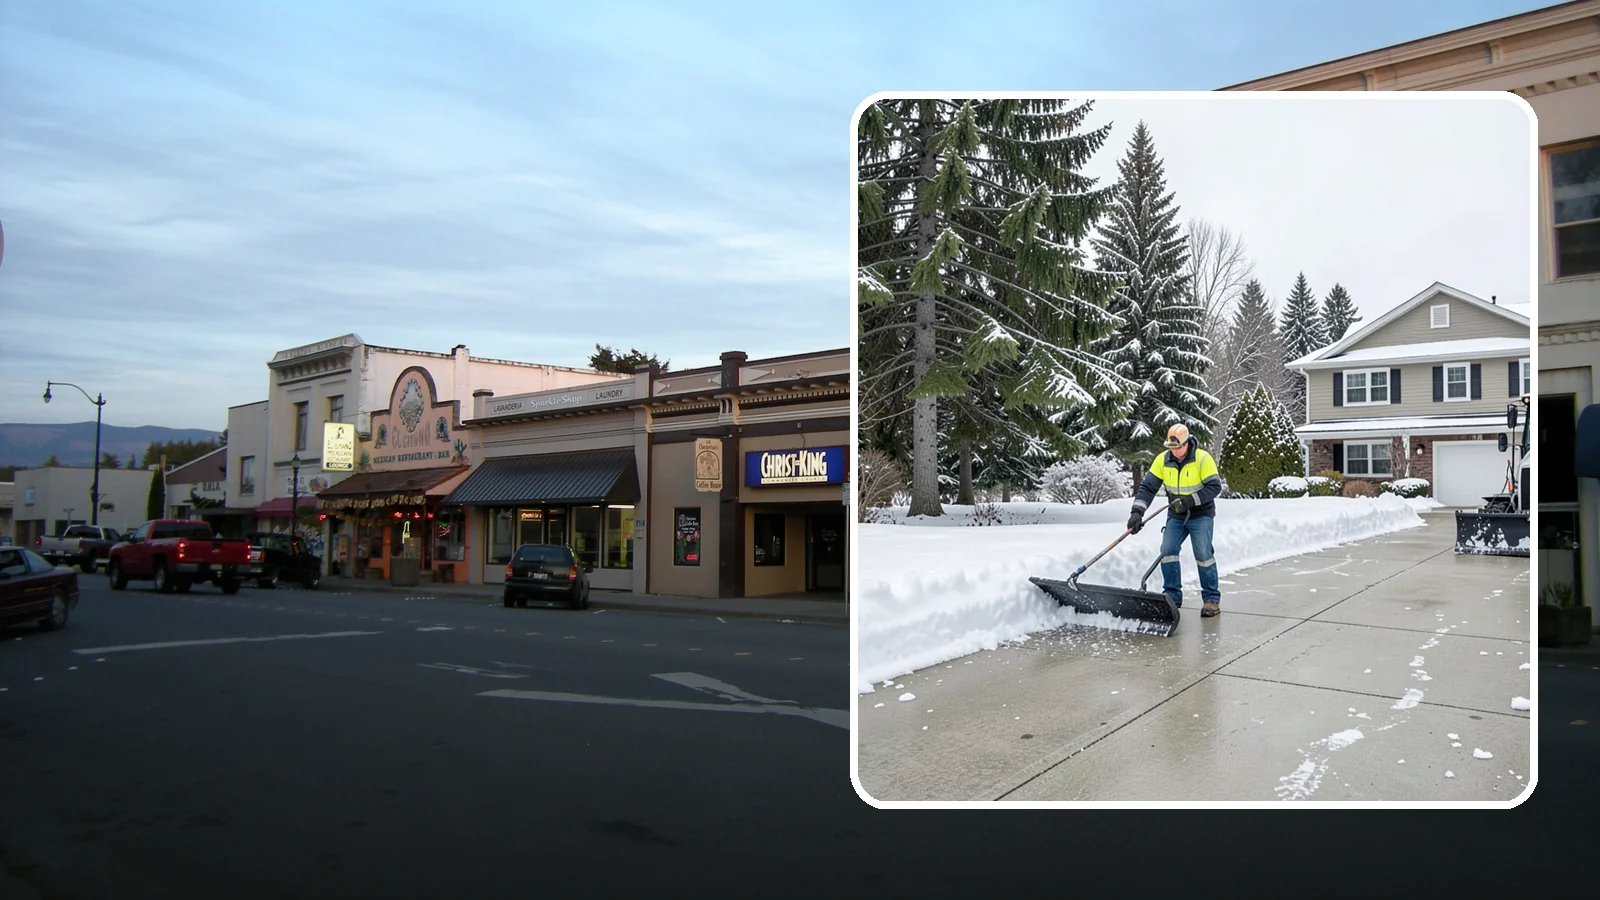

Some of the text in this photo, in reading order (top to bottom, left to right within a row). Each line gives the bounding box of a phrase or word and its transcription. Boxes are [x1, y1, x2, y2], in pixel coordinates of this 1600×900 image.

[493, 389, 623, 412] LAVANDERIA Sparkle Shop LAUNDRY
[392, 425, 401, 449] EL
[373, 450, 450, 464] MEXICAN RESTAURANT BAR
[761, 450, 827, 477] CHRIST KING
[696, 481, 722, 489] Coffee House
